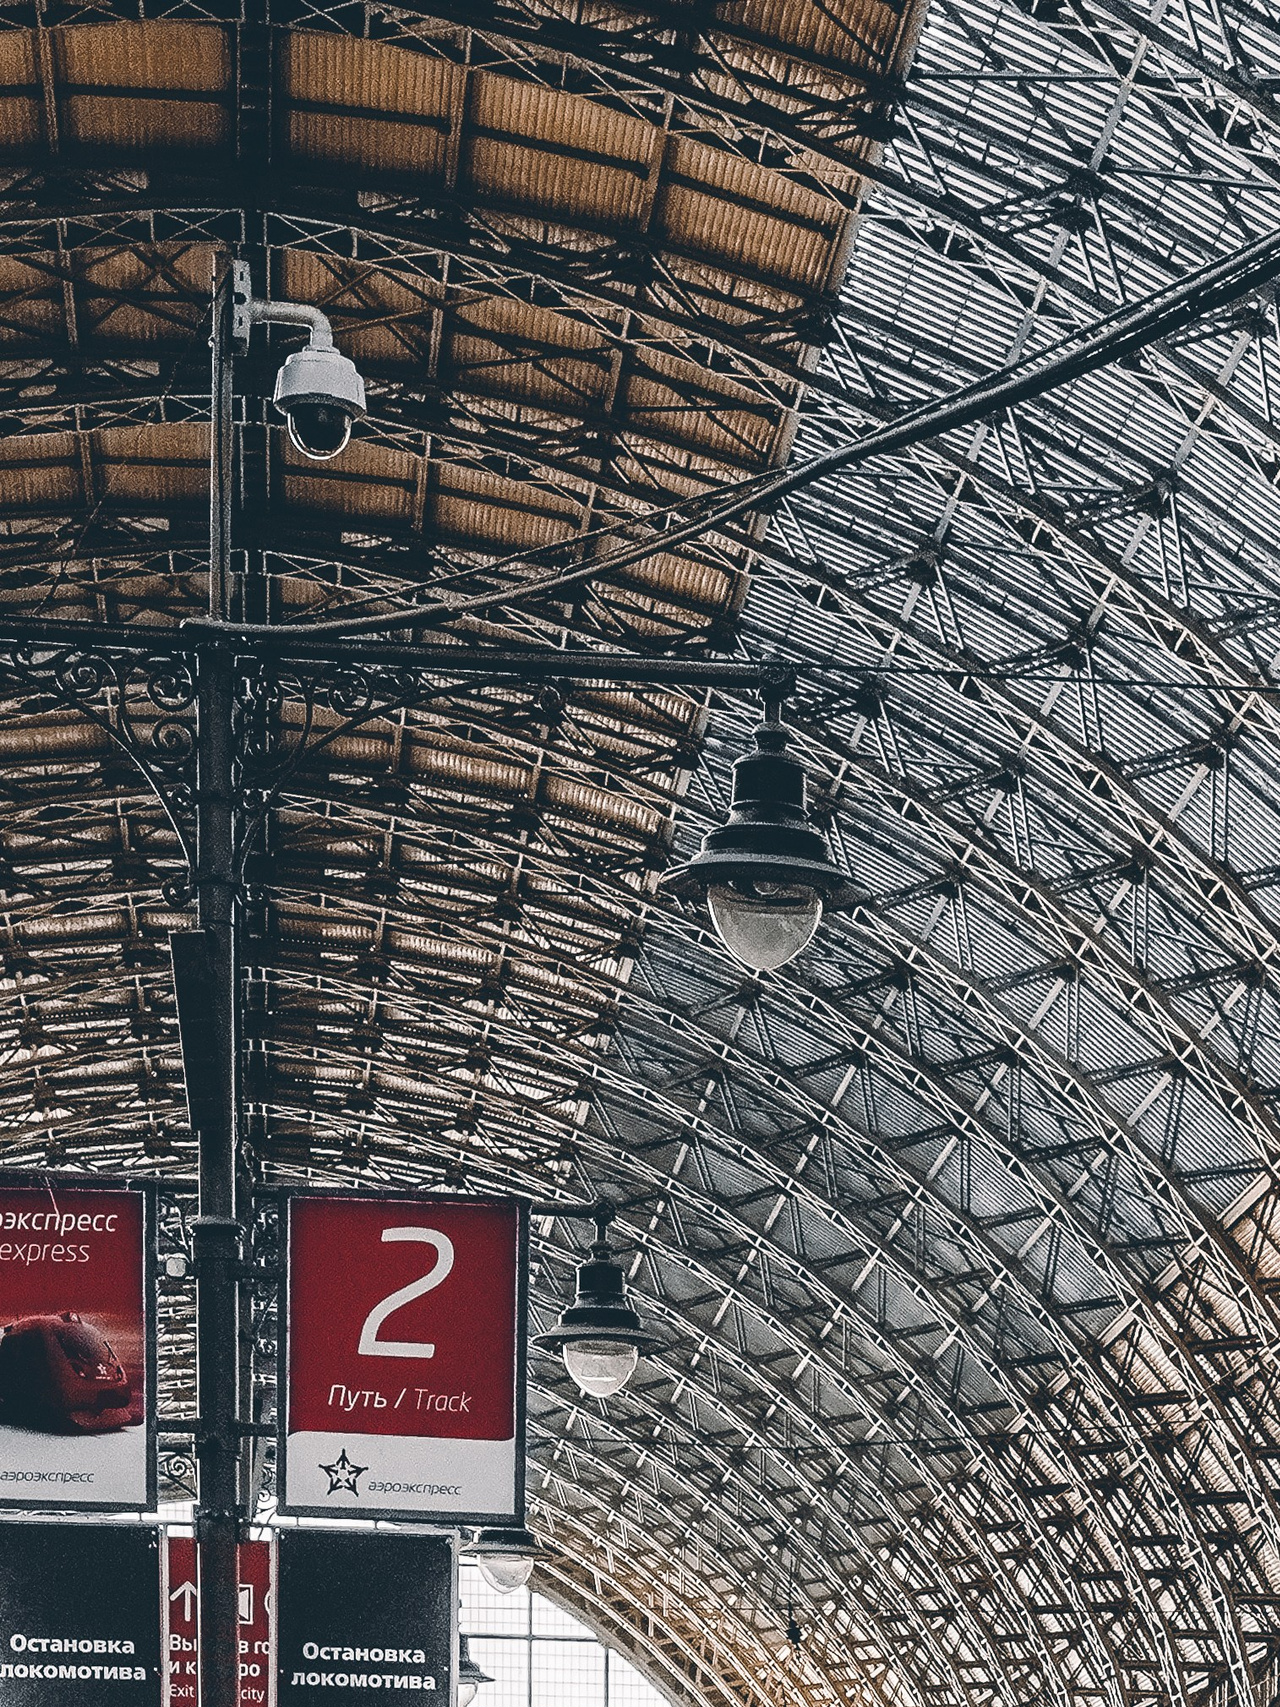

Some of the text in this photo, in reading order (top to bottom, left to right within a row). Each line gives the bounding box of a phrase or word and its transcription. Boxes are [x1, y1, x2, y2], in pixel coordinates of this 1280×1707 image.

[0, 1212, 118, 1236] экспресс
[0, 1243, 90, 1266] express
[358, 1227, 455, 1358] 2
[328, 1384, 388, 1411] Путь
[415, 1388, 472, 1412] Track
[0, 1471, 95, 1484] аэроэкспресс
[368, 1480, 462, 1496] аэроэкспресс
[10, 1633, 135, 1654] Остановка
[302, 1642, 426, 1664] Остановка
[0, 1662, 147, 1681] локомотива
[291, 1672, 437, 1691] локомотива
[170, 1683, 265, 1703] Exit city
